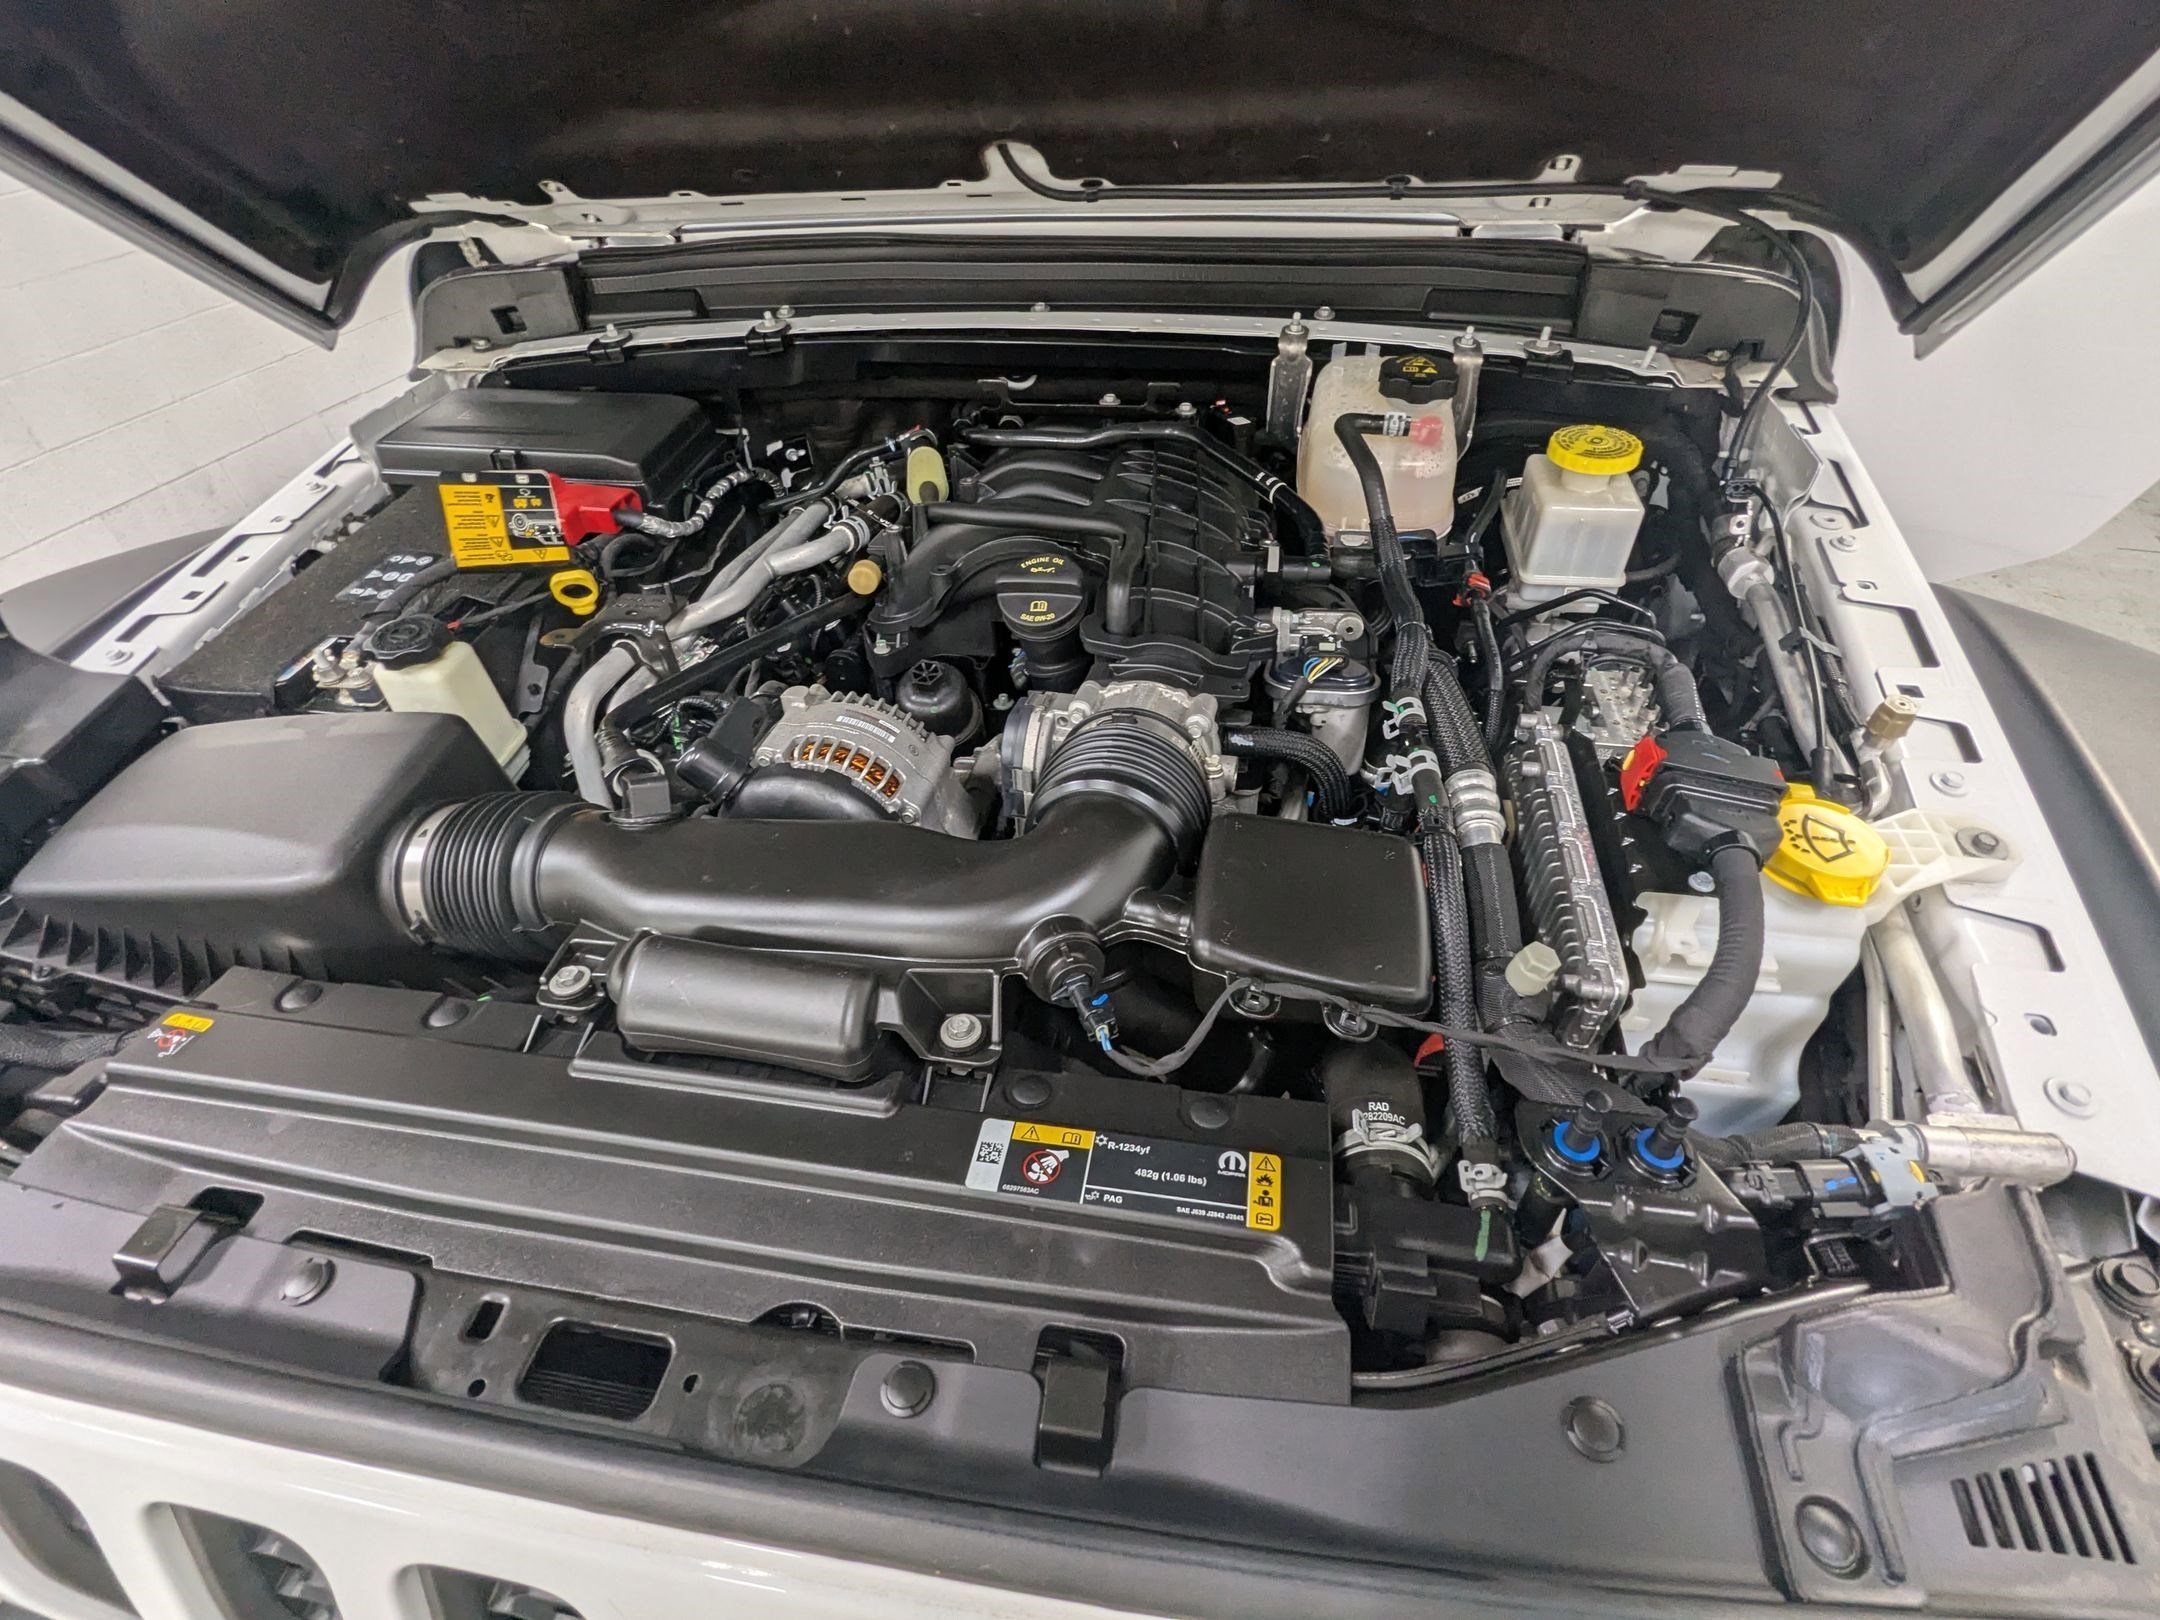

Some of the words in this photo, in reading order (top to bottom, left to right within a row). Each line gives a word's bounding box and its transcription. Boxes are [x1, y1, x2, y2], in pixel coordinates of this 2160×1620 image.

[1020, 557, 1049, 568] ENGINE
[1020, 613, 1034, 621] SAE
[1368, 1101, 1389, 1112] RAD
[1107, 1140, 1151, 1156] R-1234yf
[1134, 1167, 1160, 1181] 482g
[1187, 1174, 1208, 1188] lbs)
[1103, 1193, 1123, 1205] PAG
[1176, 1206, 1190, 1215] SAE
